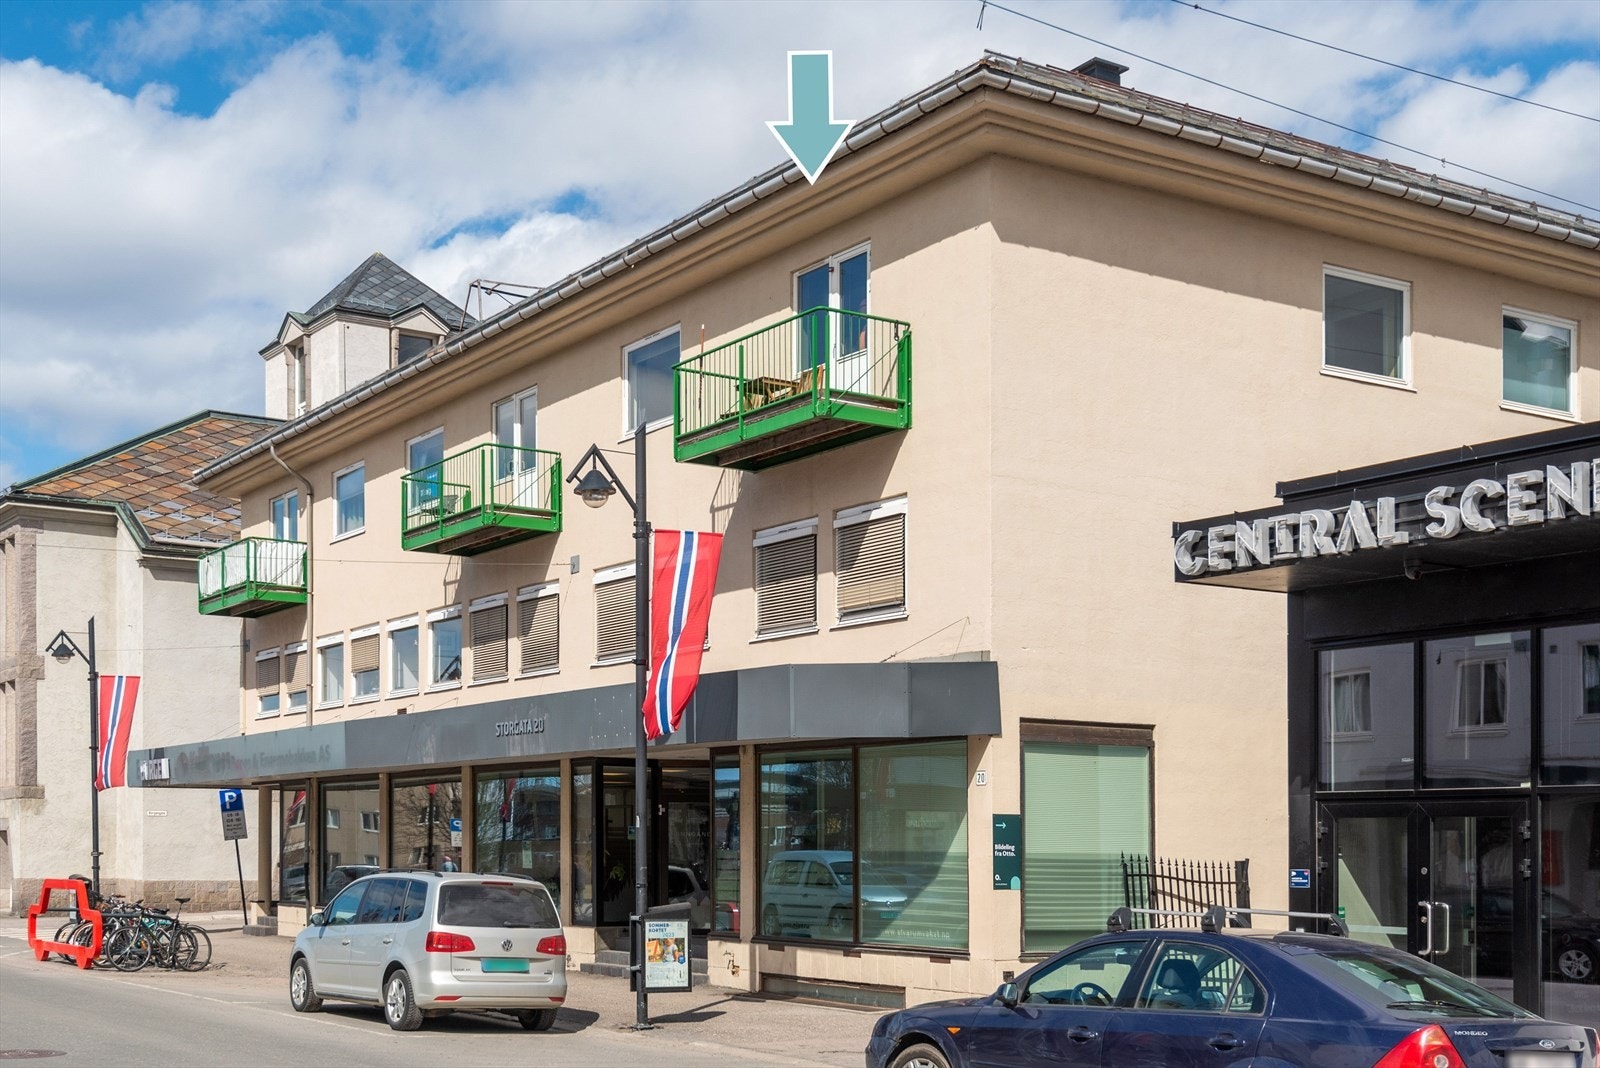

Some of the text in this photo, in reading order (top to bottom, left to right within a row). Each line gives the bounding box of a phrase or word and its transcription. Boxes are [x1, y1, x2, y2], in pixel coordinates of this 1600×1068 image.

[1174, 459, 1600, 576] CENTRAL SCEN
[495, 717, 545, 737] STORGATA 20
[977, 772, 985, 784] 20
[224, 791, 237, 809] P
